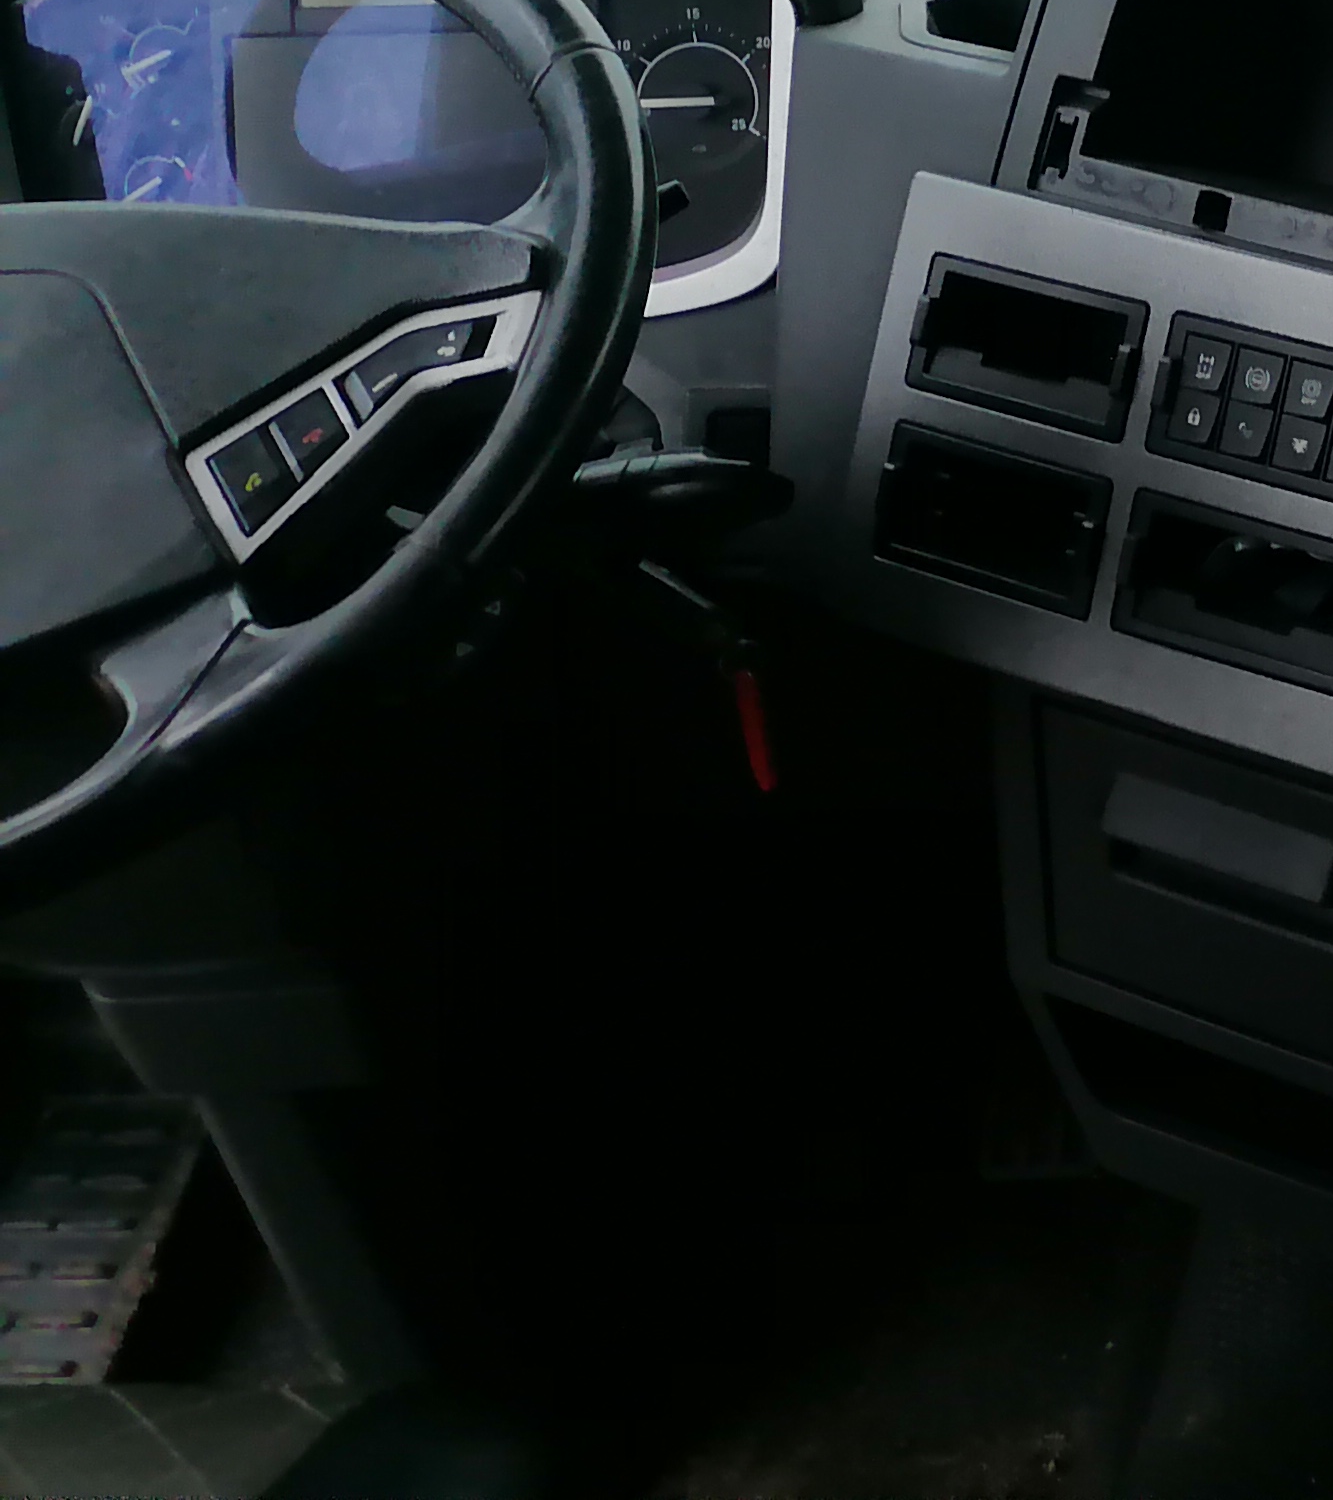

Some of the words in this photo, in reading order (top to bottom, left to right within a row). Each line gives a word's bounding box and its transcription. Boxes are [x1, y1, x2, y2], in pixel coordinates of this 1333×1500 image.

[686, 7, 701, 20] 15
[616, 39, 631, 51] 10
[755, 36, 771, 49] 20
